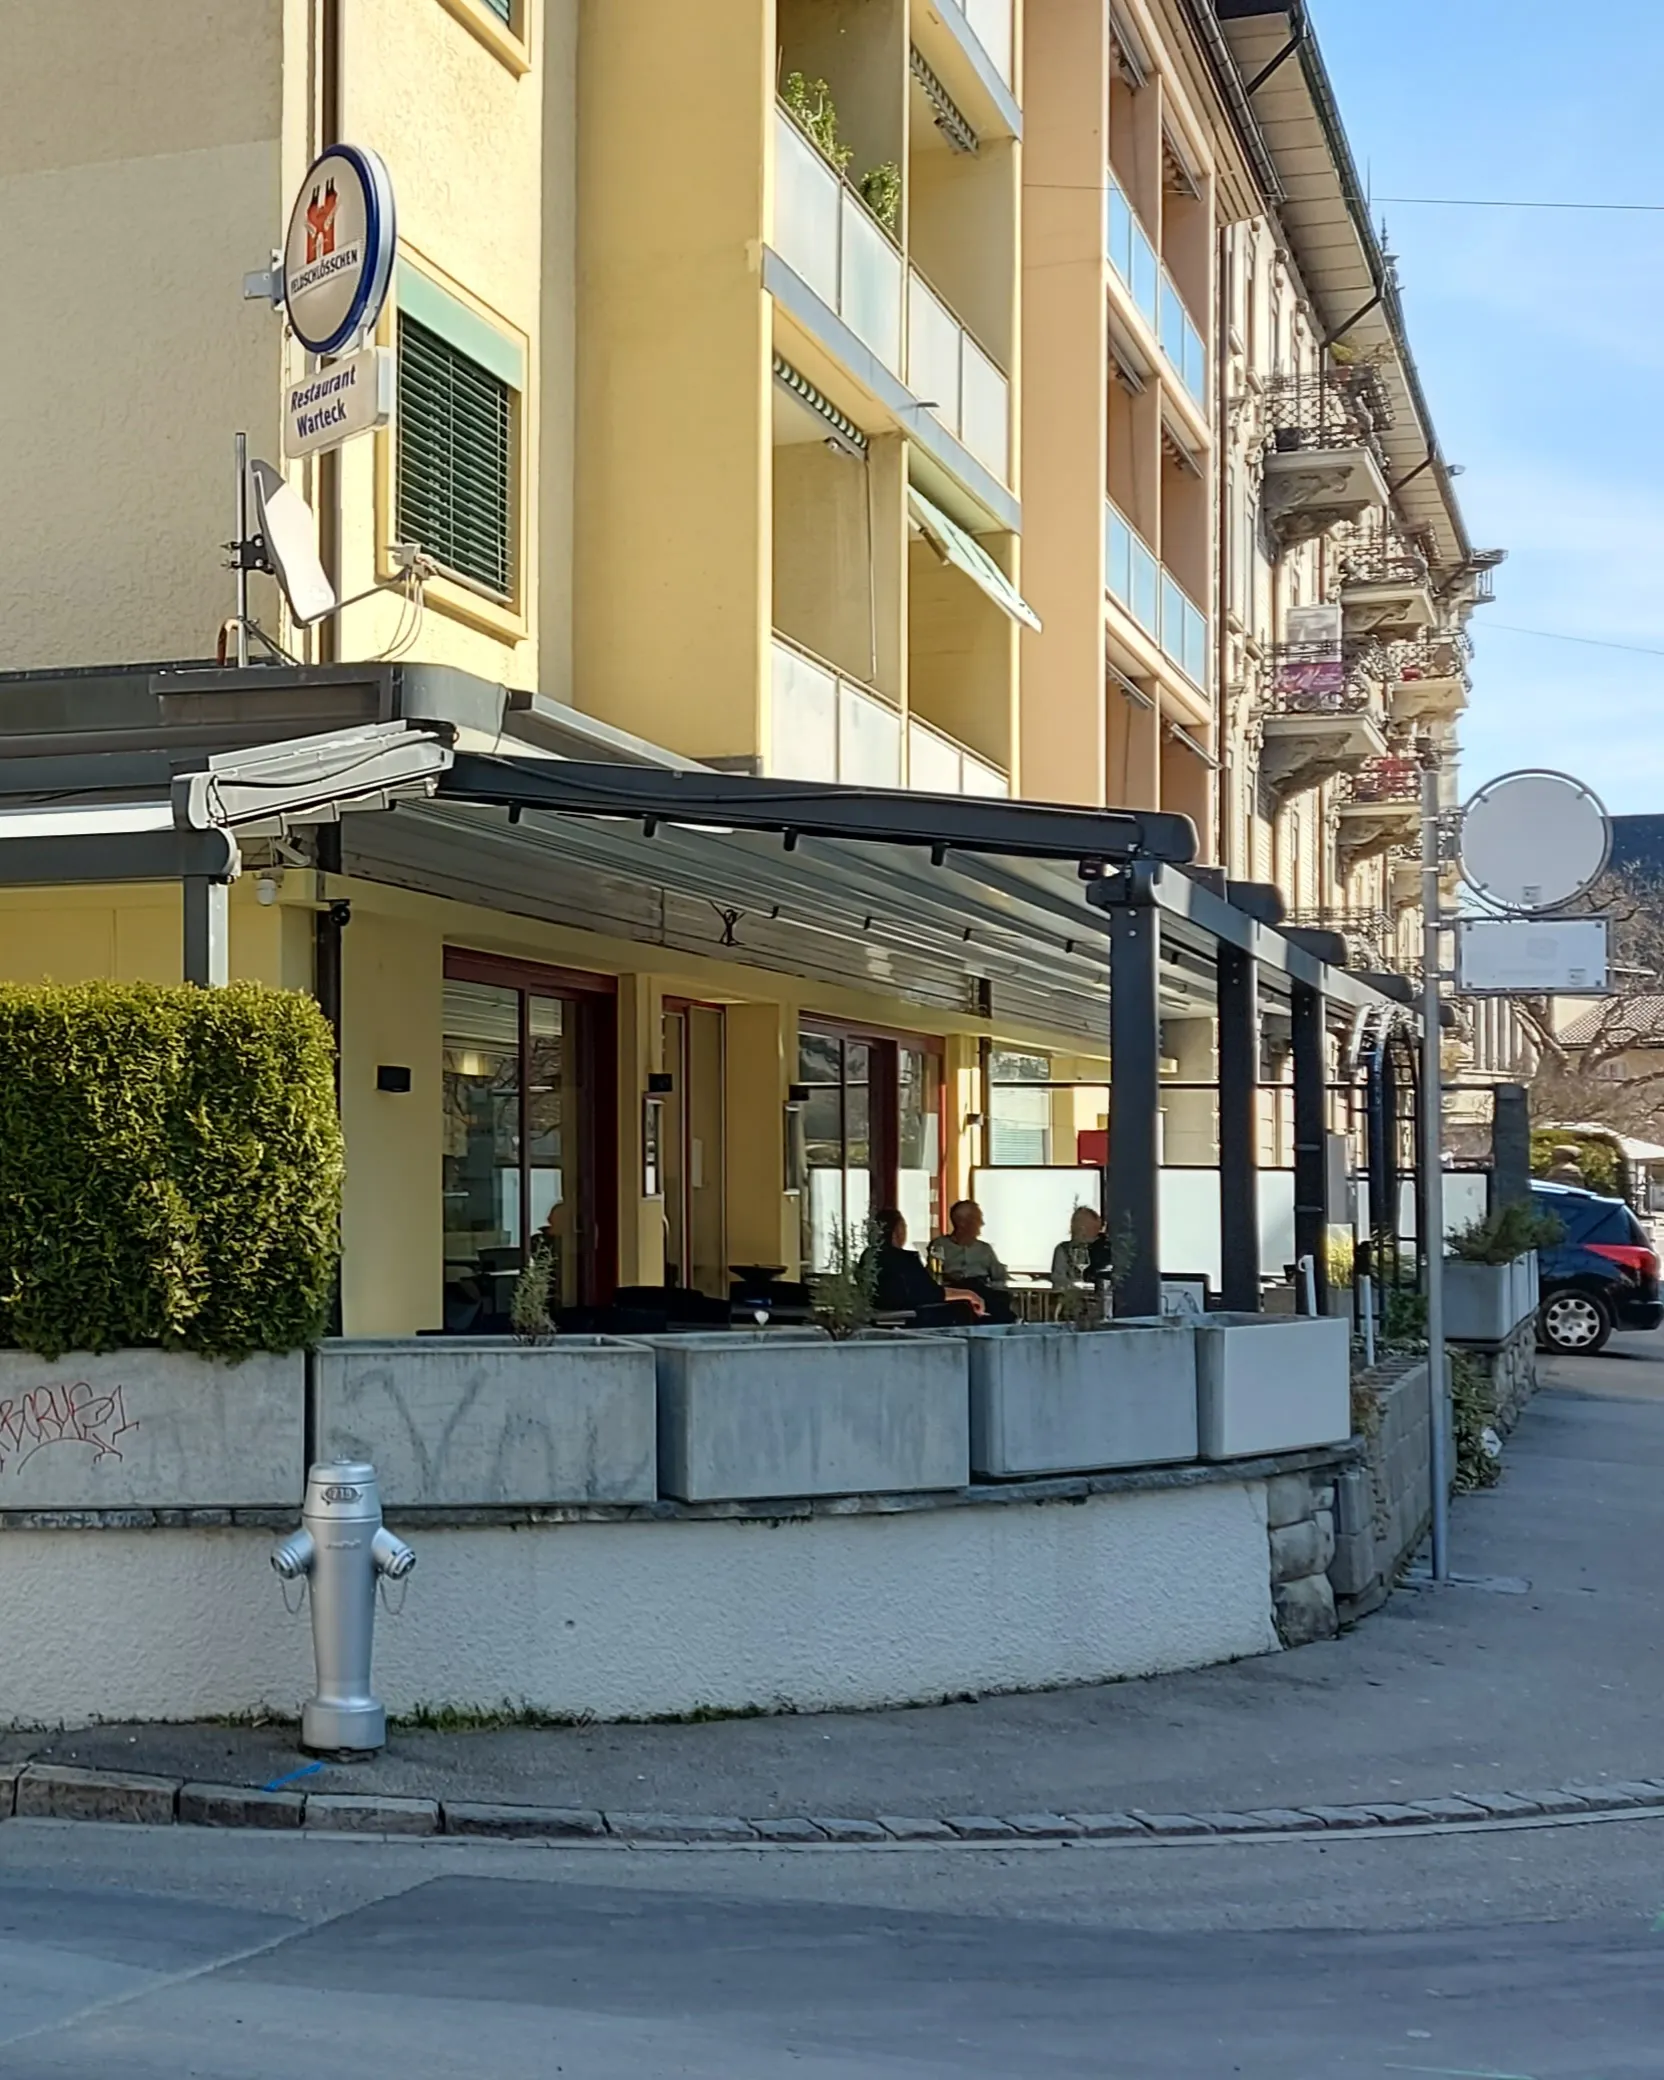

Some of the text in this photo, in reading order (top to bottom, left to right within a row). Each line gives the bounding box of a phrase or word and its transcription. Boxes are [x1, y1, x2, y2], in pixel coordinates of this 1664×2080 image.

[290, 248, 358, 296] FELDSCHLÖSSCHEN
[291, 364, 356, 413] Restaurant
[297, 398, 347, 438] Warteck
